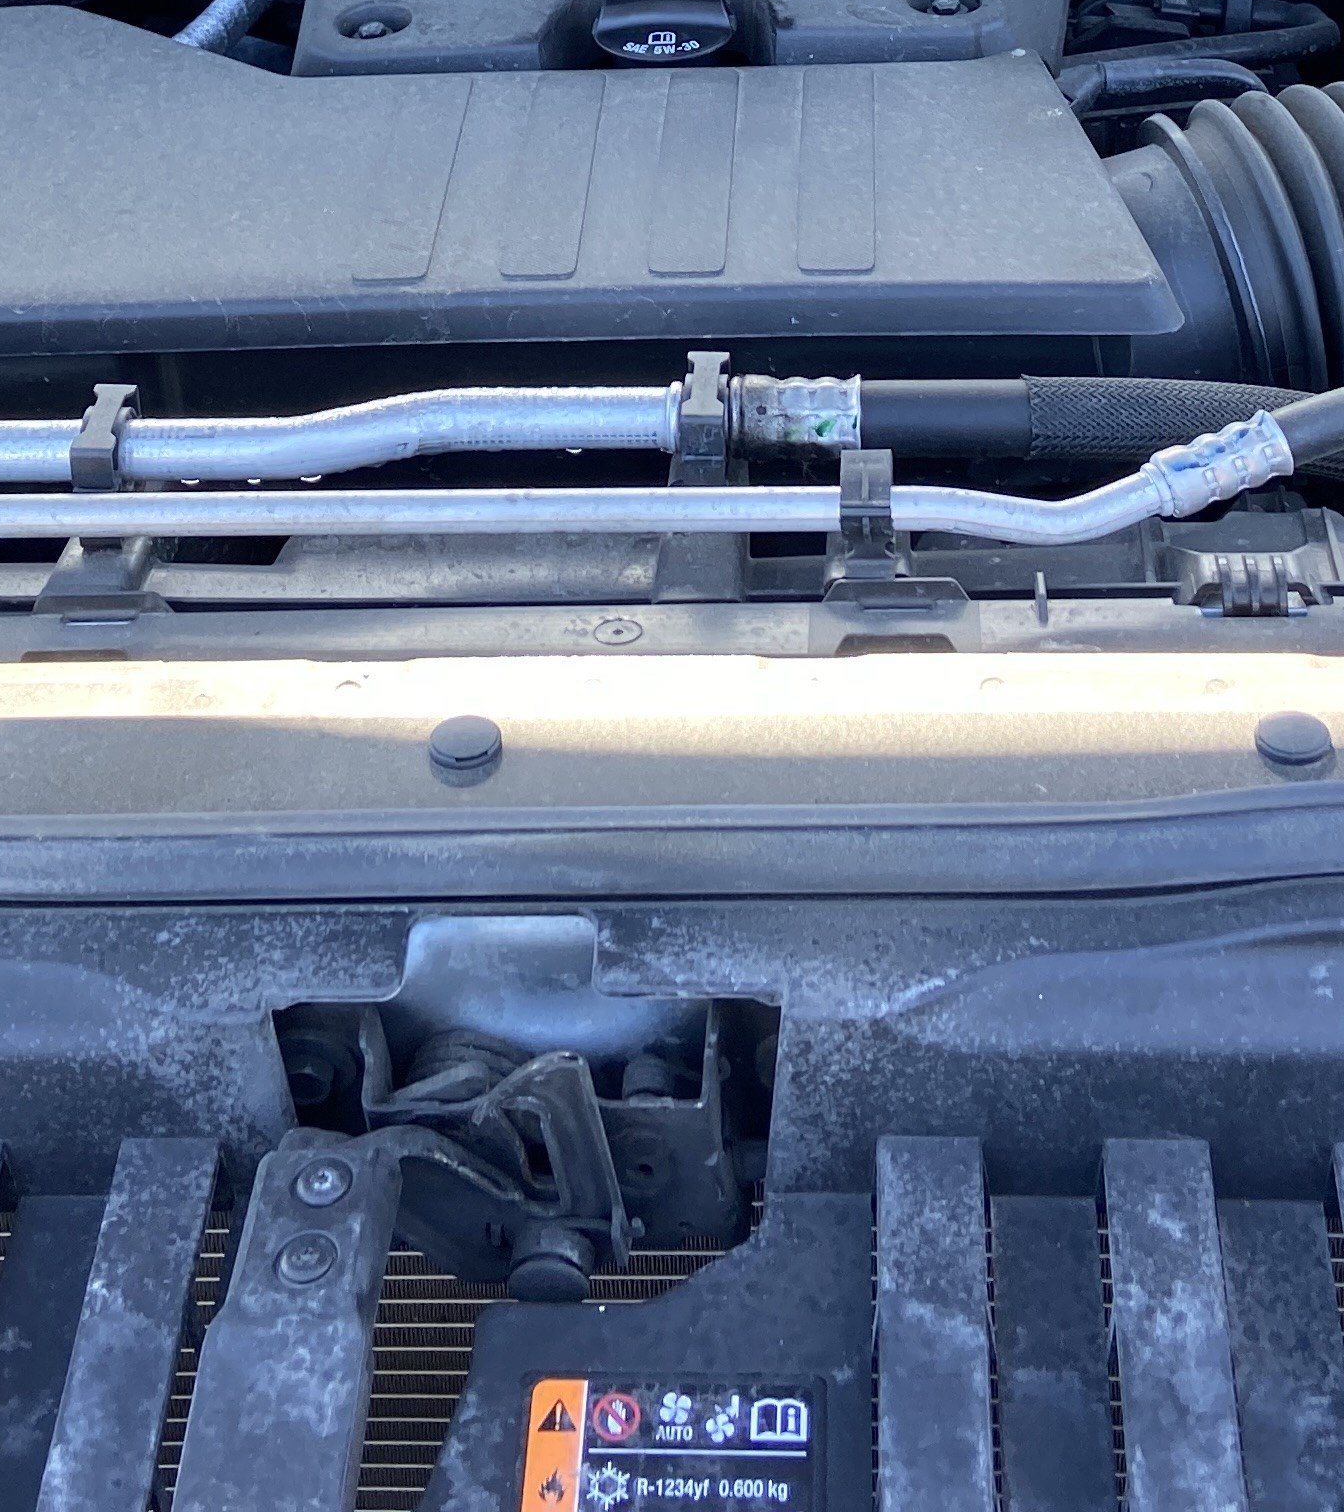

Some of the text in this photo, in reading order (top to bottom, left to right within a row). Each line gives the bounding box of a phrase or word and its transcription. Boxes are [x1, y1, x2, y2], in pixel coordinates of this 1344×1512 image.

[622, 40, 701, 55] SAE 5W-30
[656, 1424, 694, 1441] AUTO
[637, 1477, 789, 1502] R-1234yf 0.600 kg
